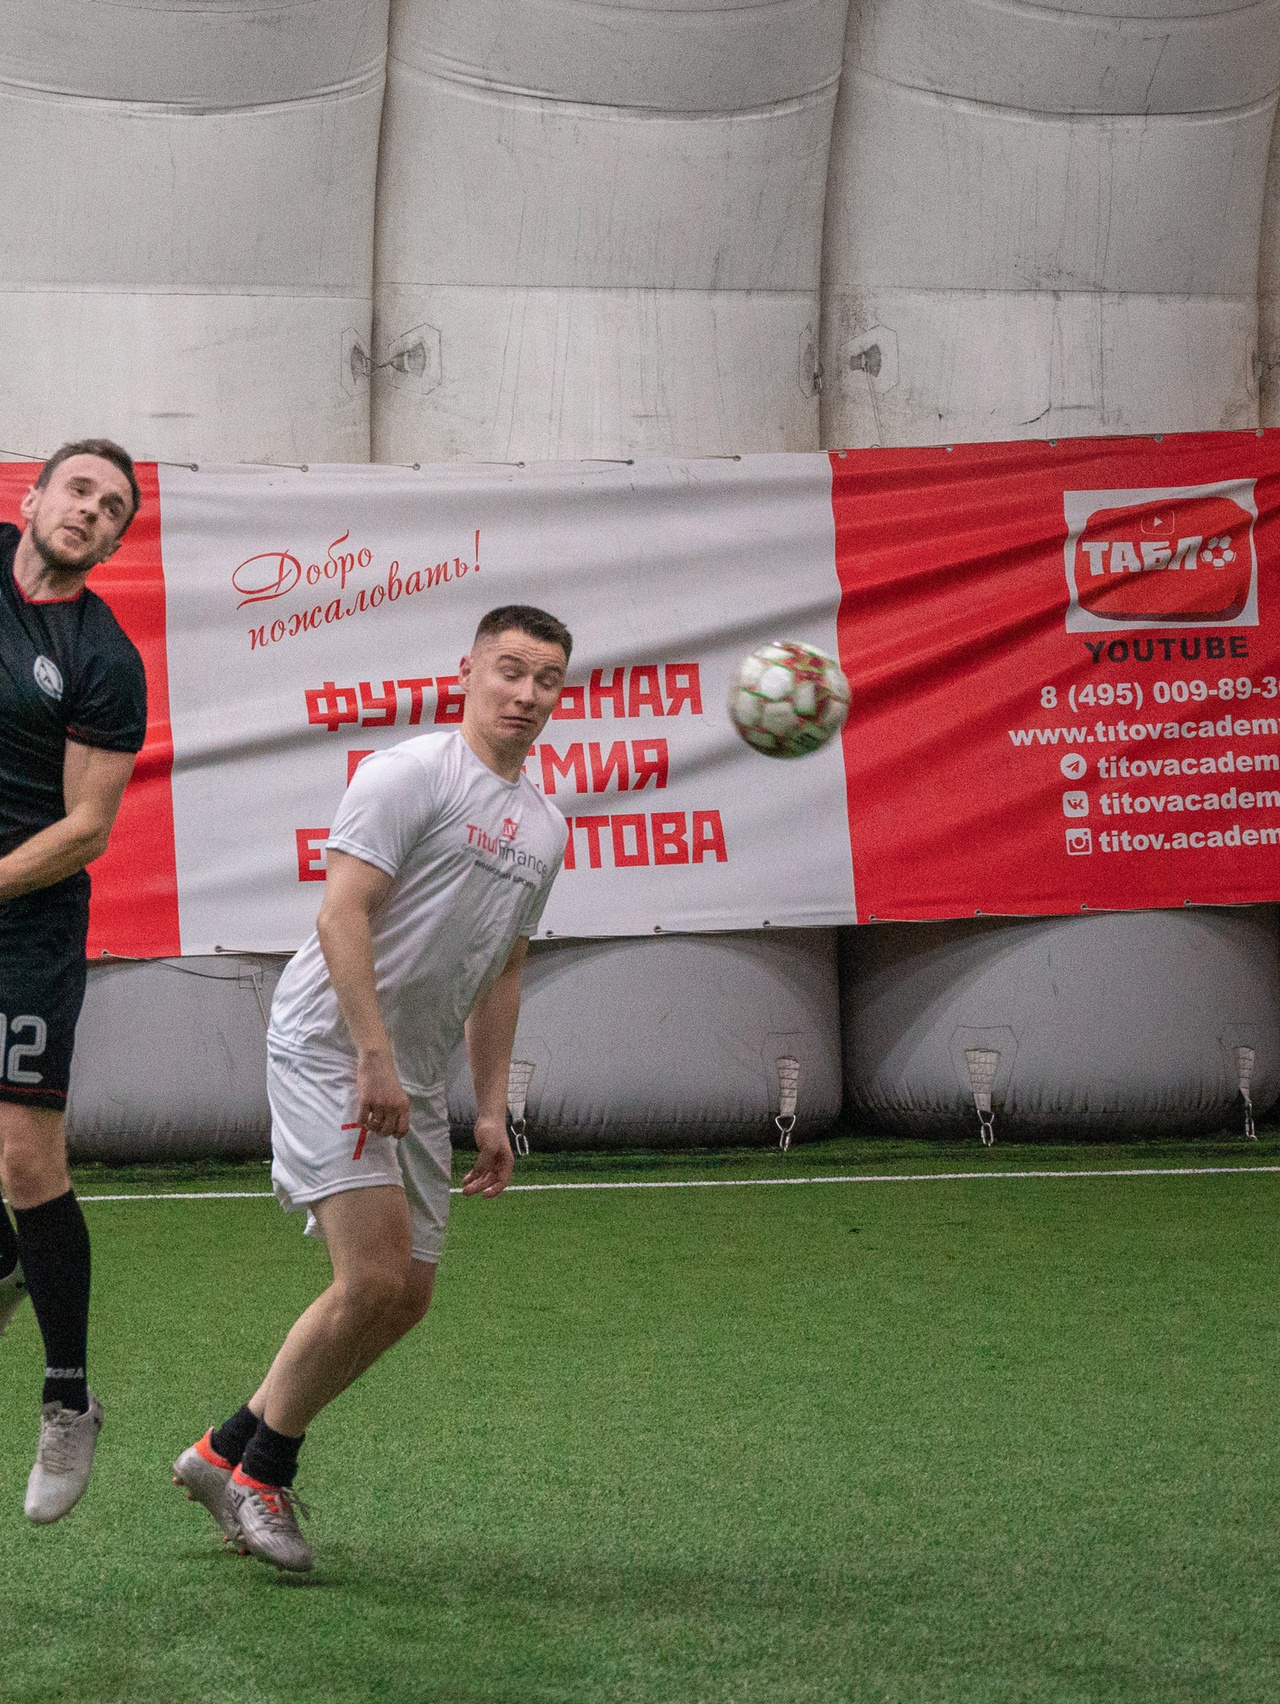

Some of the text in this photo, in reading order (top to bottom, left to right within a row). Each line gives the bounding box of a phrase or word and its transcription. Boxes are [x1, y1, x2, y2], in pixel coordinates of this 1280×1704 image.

[232, 529, 373, 610] Добро
[248, 530, 481, 650] пожаловать!
[1084, 636, 1249, 664] YOUTUBE
[1040, 676, 1280, 712] 8 (495) 009-89-3
[1008, 714, 1280, 747] www.titovacadem
